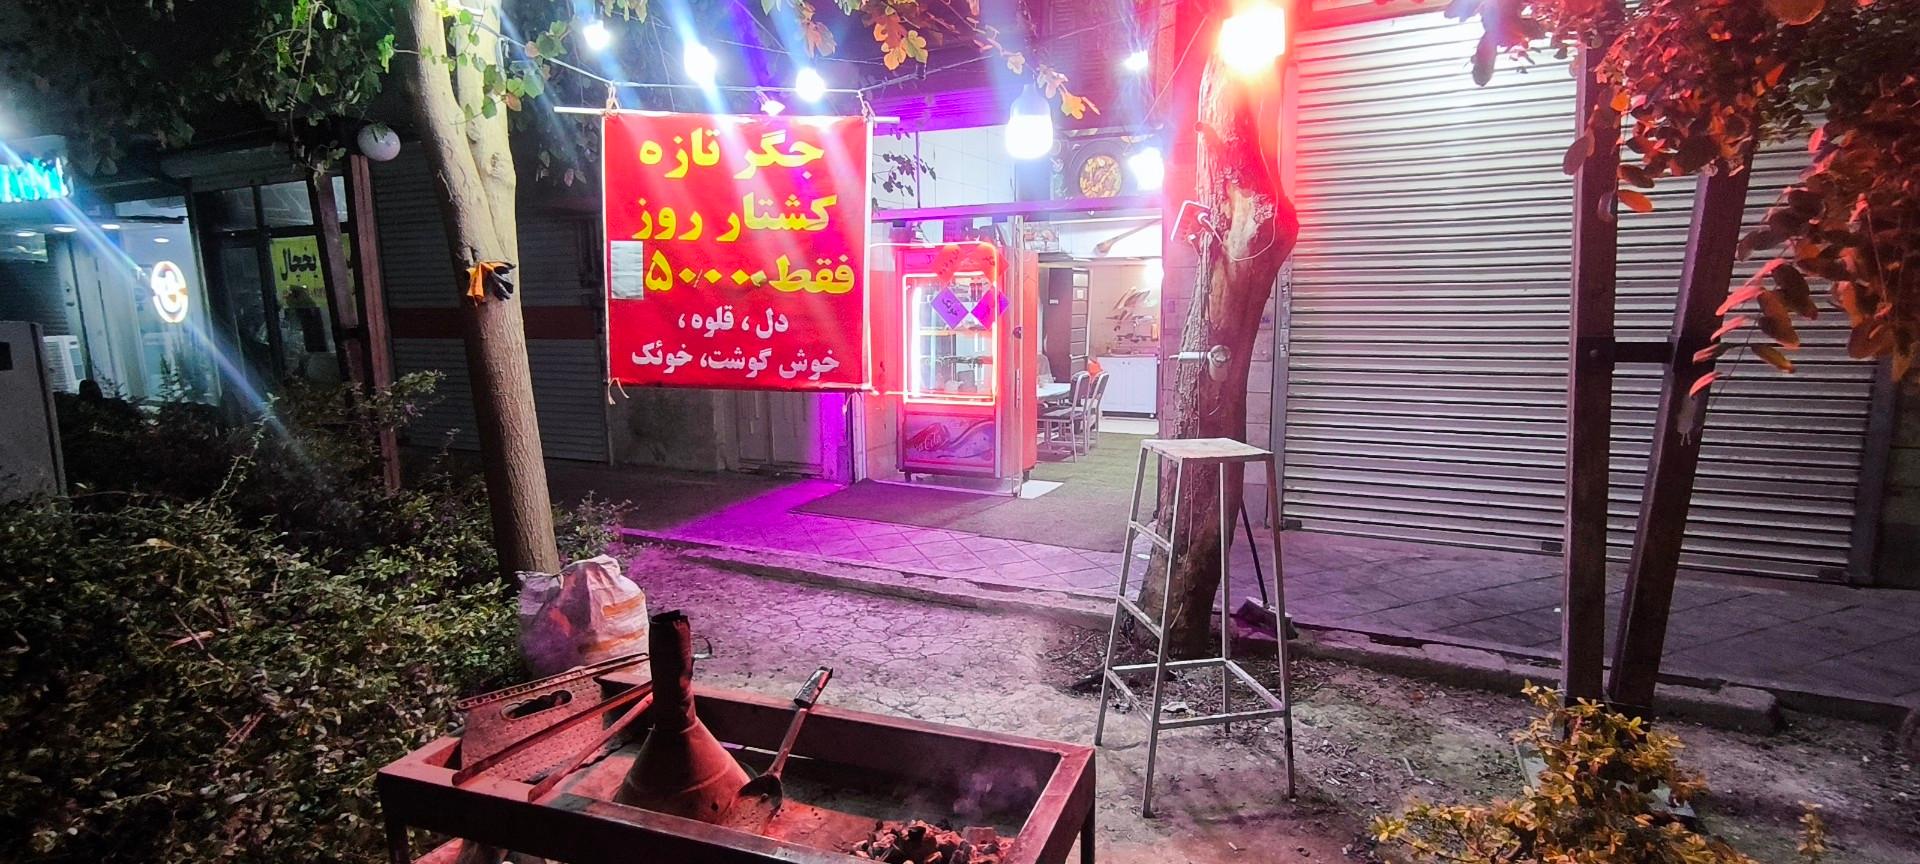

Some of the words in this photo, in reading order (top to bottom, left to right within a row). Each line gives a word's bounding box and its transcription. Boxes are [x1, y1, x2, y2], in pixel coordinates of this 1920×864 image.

[639, 127, 721, 179] تازه
[733, 129, 825, 180] جگر
[631, 198, 703, 240] روز
[716, 192, 838, 242] کشتار
[768, 254, 855, 294] فقط
[691, 304, 735, 338] قلوه
[755, 307, 789, 339] دل
[631, 339, 694, 374] خوئک
[778, 348, 840, 381] خوش
